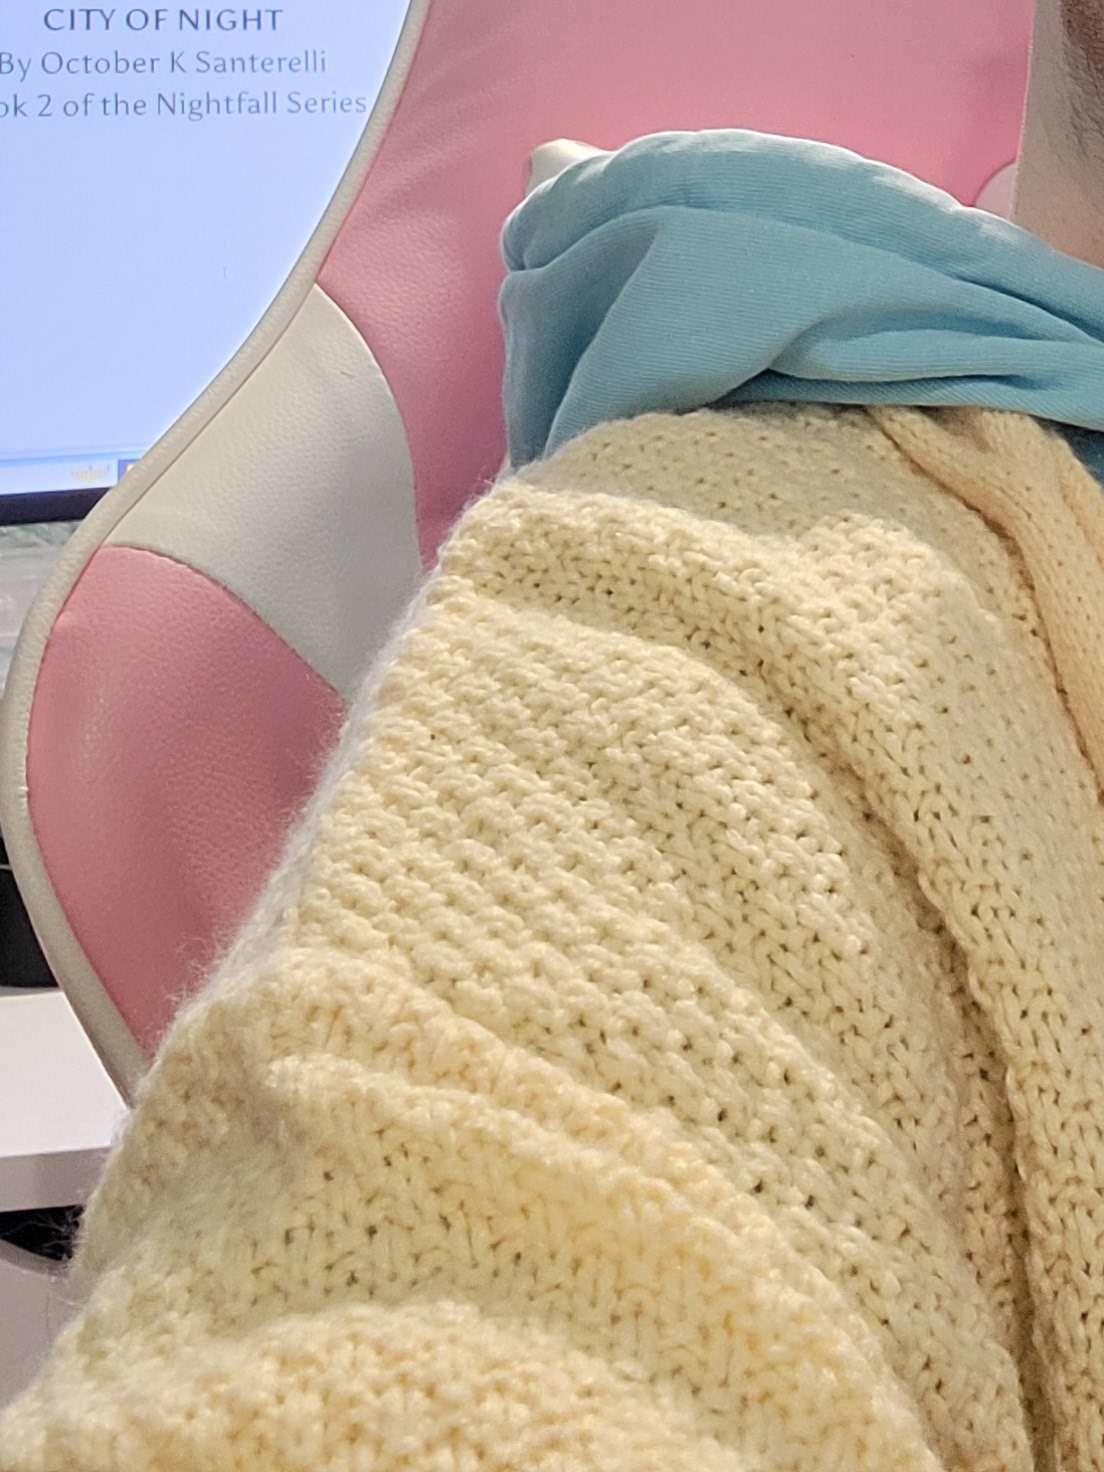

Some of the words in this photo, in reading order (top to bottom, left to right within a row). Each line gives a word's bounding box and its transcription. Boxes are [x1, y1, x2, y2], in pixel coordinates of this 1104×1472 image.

[43, 8, 116, 31] CITY
[125, 8, 169, 31] OF
[179, 8, 284, 31] NIGHT
[0, 51, 32, 83] By
[41, 49, 161, 75] October
[170, 50, 188, 74] K
[195, 48, 327, 74] Santerelli
[37, 93, 53, 118] 2
[63, 92, 96, 118] of
[101, 91, 147, 117] the
[156, 89, 278, 123] Nightfall
[287, 90, 368, 115] Series
